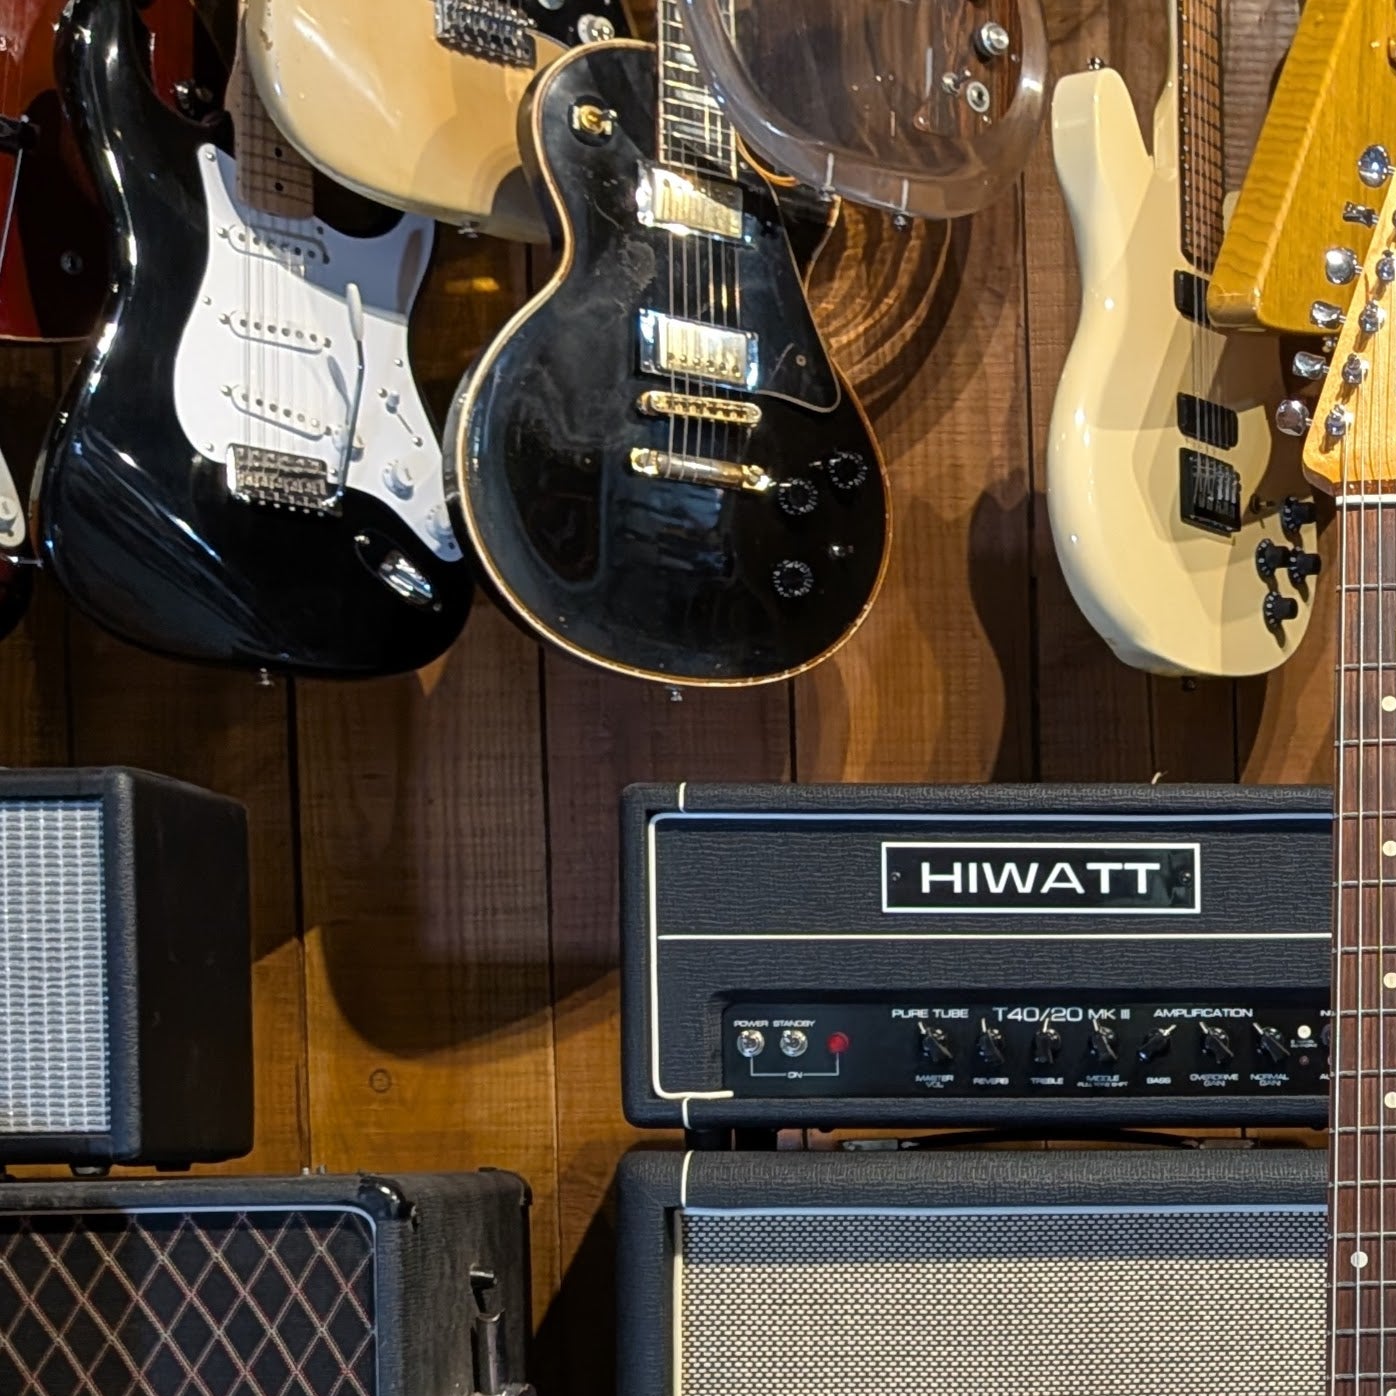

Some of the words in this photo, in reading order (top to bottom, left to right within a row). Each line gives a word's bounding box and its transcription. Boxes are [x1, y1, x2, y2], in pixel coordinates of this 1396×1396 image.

[921, 862, 1160, 894] HIWATT
[892, 1009, 928, 1018] PURE
[932, 1009, 968, 1018] TUBE
[994, 1007, 1082, 1021] T40/20
[1087, 1009, 1116, 1020] MK
[1153, 1009, 1253, 1018] AMPLIFICATION
[1030, 1077, 1064, 1085] TREBLE
[1190, 1073, 1239, 1081] OVERDRIVE
